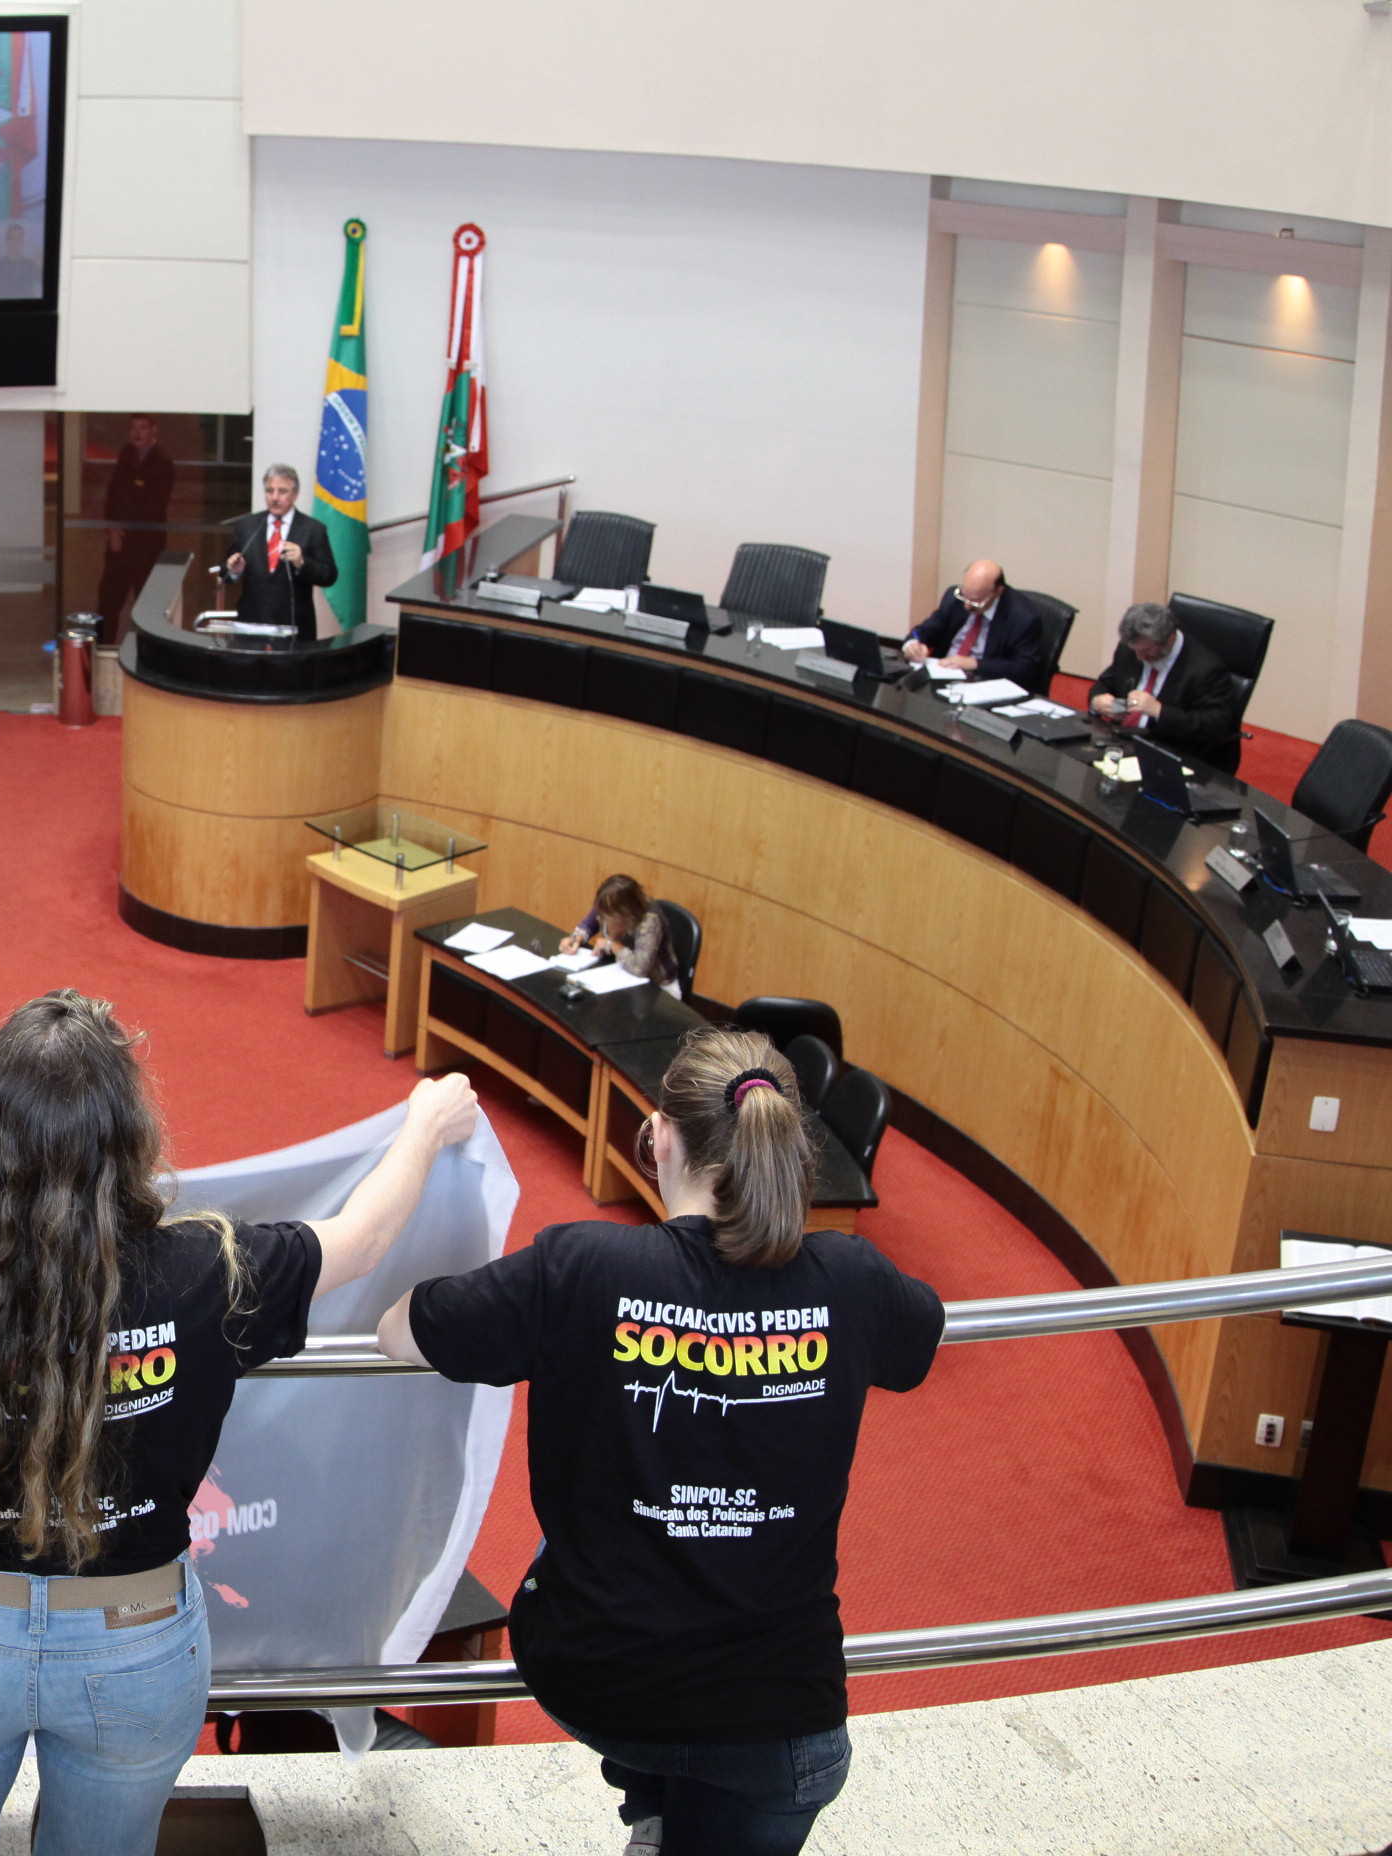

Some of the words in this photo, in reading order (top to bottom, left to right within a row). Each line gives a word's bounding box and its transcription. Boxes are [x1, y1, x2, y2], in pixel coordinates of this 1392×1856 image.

[617, 1297, 706, 1330] POLICIAIS
[707, 1311, 756, 1334] CIVIS
[761, 1306, 829, 1331] PEDEM
[108, 1321, 176, 1352] PEDEM
[613, 1321, 828, 1376] SOCORRO
[762, 1378, 826, 1397] DIGNIDADE
[104, 1387, 174, 1416] DIGNIDADE
[670, 1484, 756, 1506] SINPOL-SC
[633, 1499, 684, 1522] Sindicato
[687, 1506, 708, 1521] dos
[712, 1507, 765, 1522] Policiais
[769, 1504, 795, 1520] Civis
[667, 1522, 699, 1538] Santa
[701, 1522, 753, 1538] Catarina
